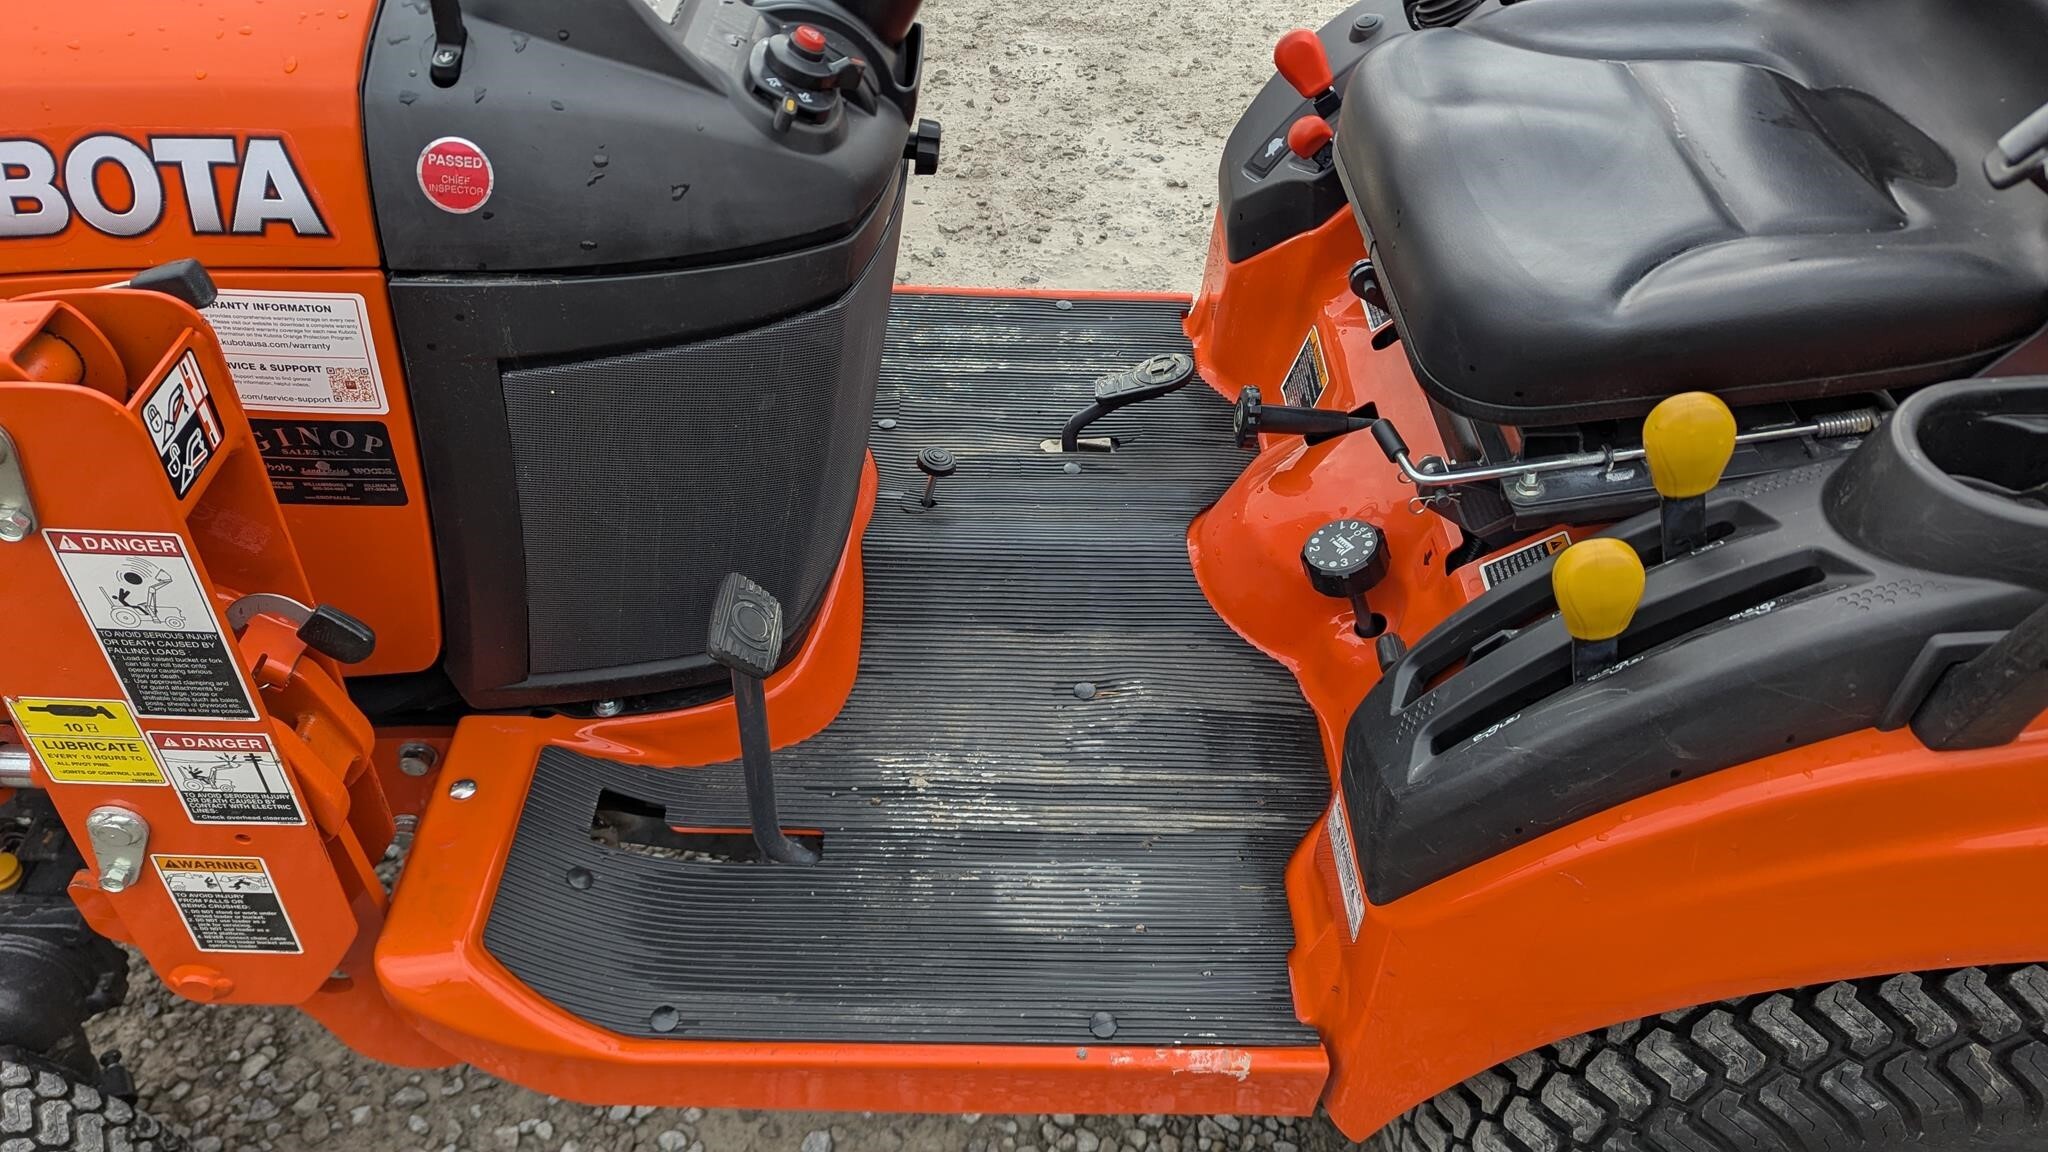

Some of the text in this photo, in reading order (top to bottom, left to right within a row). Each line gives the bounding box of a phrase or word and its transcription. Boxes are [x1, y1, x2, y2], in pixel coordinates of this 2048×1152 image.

[428, 154, 482, 168] PASSED
[441, 174, 470, 185] CHIEF
[0, 134, 330, 237] BOTA
[428, 184, 484, 196] INSPECTOR
[253, 302, 332, 312] INFORMATION
[270, 364, 321, 373] SUPPORT
[1340, 521, 1346, 529] 1
[81, 537, 178, 552] DANGER
[1340, 558, 1348, 567] 3
[64, 723, 83, 732] 10
[42, 740, 140, 752] LUBRICATE
[181, 738, 263, 749] DANGER
[178, 860, 257, 870] WARNING
